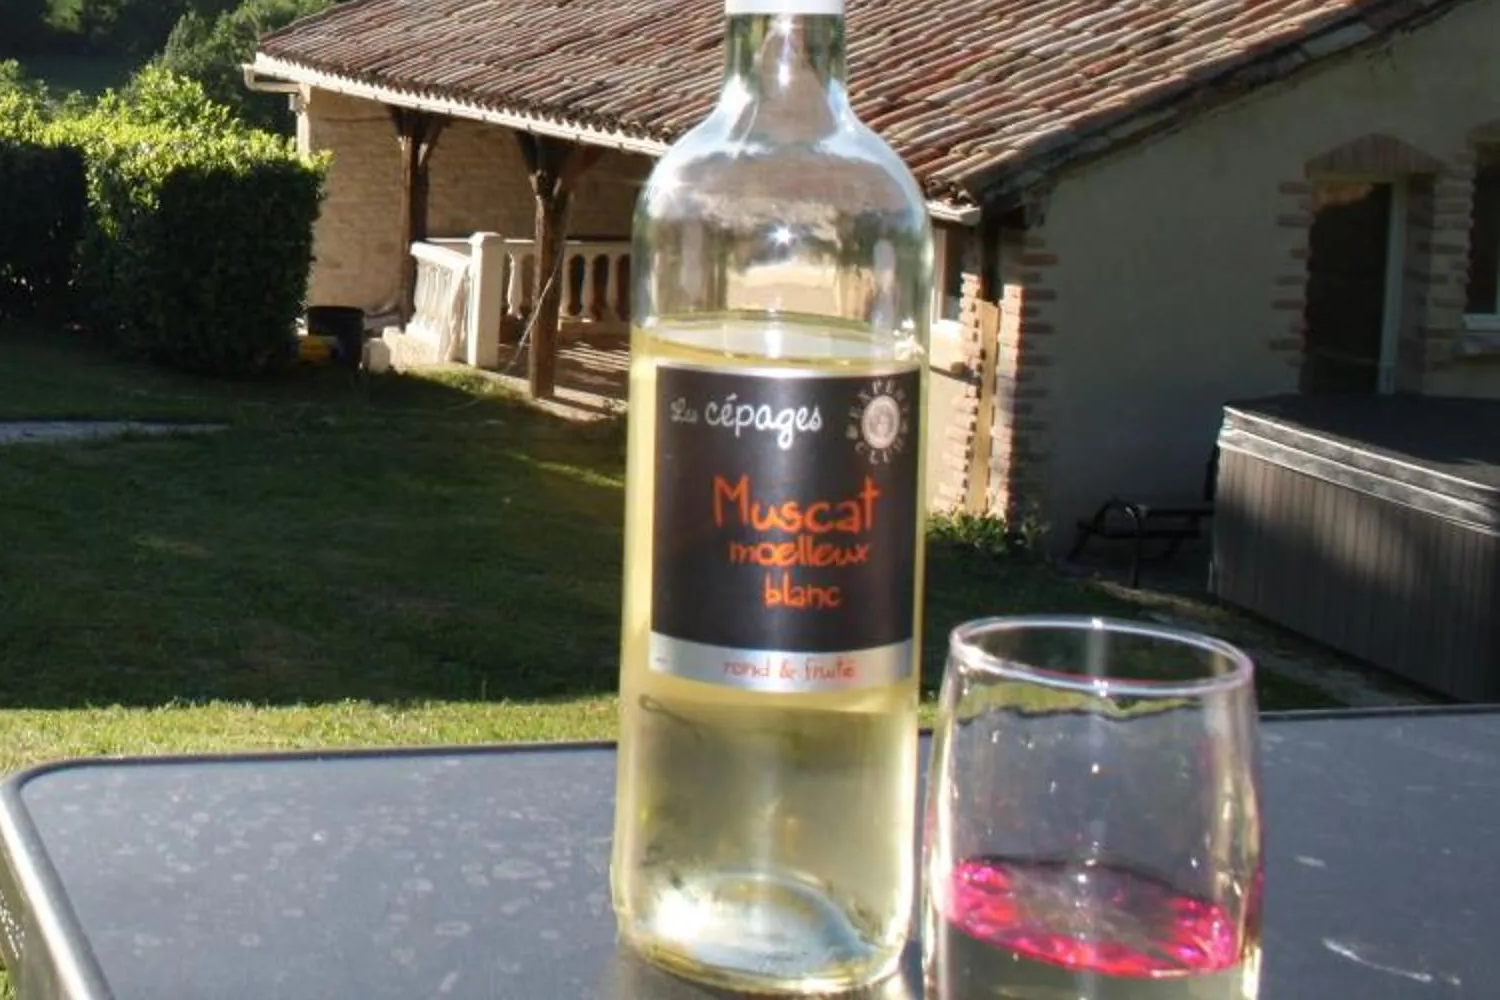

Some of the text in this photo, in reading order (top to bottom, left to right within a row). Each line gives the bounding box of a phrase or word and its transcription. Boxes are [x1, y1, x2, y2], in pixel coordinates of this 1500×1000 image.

[704, 392, 823, 451] cépages
[711, 474, 881, 535] Muscat
[729, 535, 871, 568] moelleux
[763, 572, 842, 610] blanc
[723, 658, 770, 679] rond
